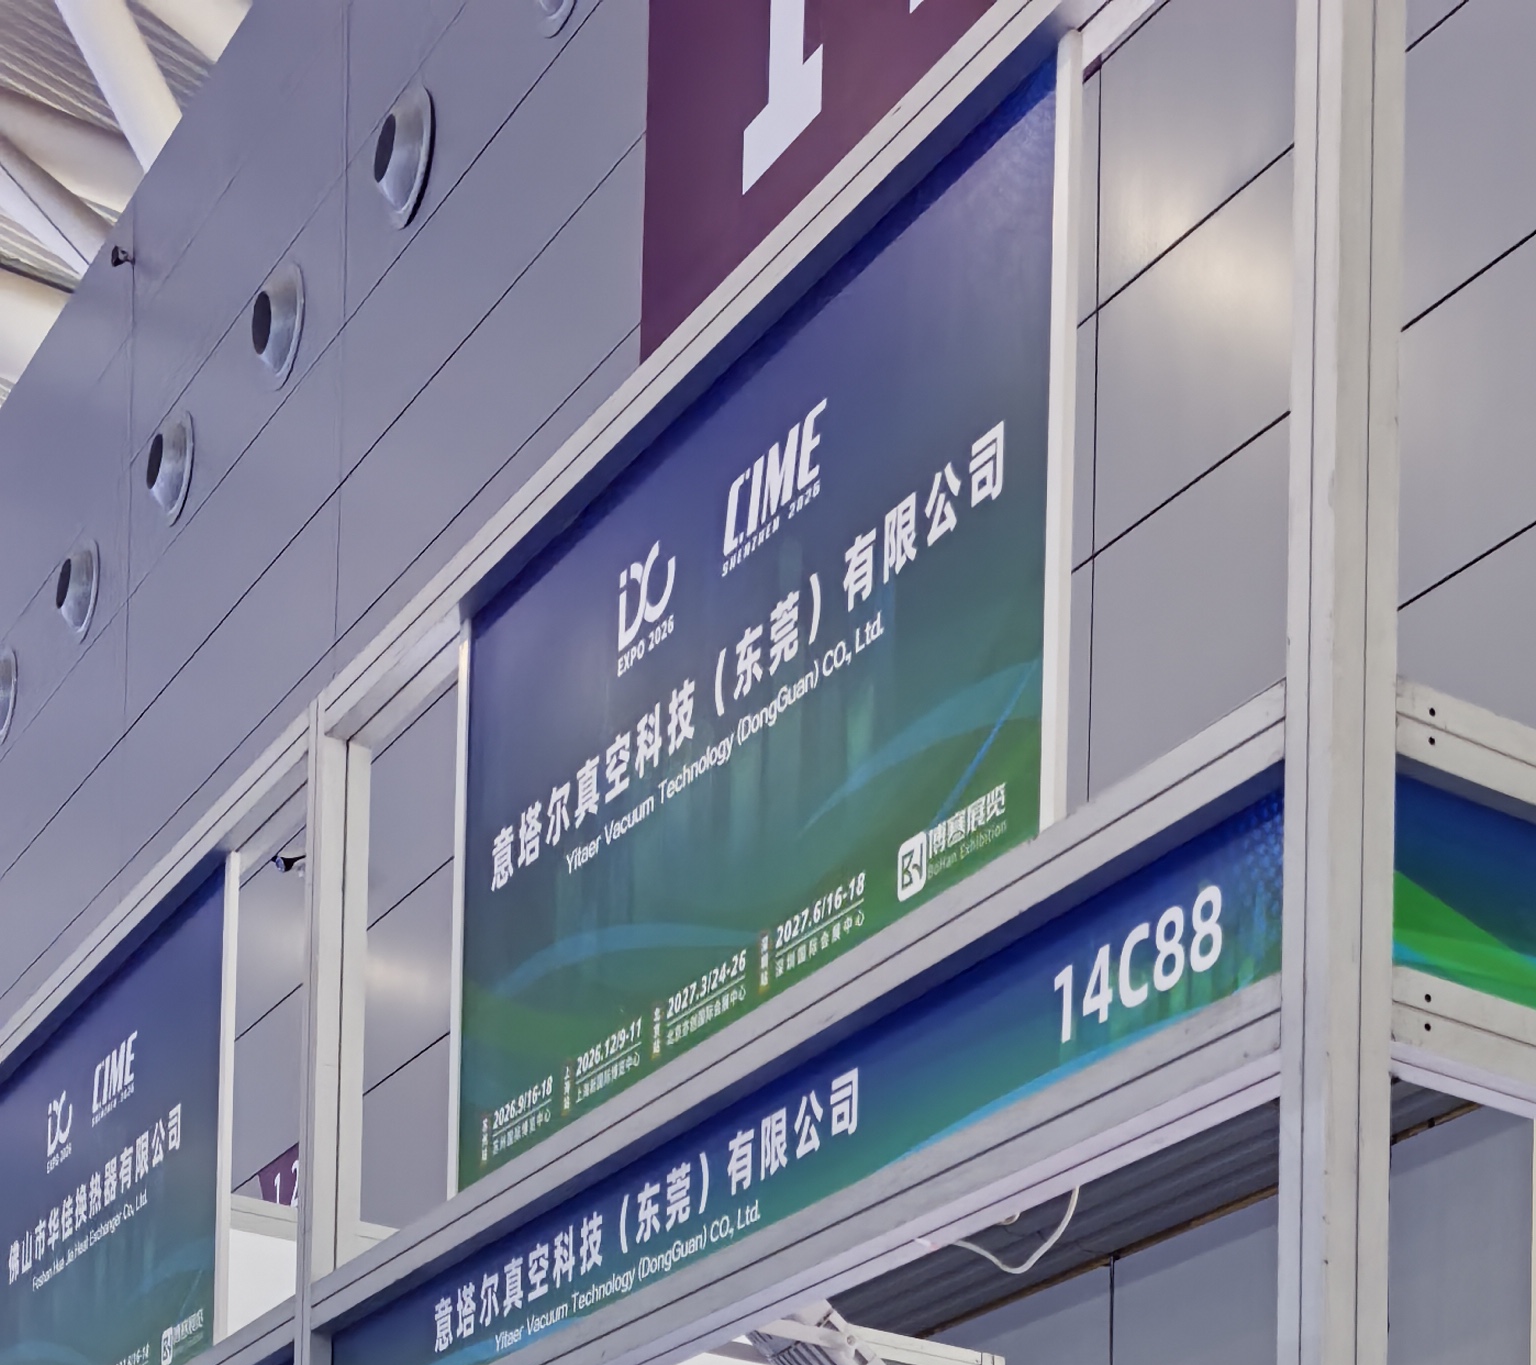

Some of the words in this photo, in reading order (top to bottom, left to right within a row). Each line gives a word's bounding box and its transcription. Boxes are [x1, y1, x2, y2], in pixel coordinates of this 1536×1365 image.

[722, 516, 780, 577] SHENZHEN
[788, 480, 820, 519] 2026
[490, 420, 1006, 893] 意塔尔真空科技（东莞）有限公司
[617, 639, 646, 678] EXPO
[647, 614, 674, 659] 2026
[566, 835, 603, 875] Yitaer
[604, 798, 655, 848] Vacuum
[658, 732, 735, 804] Technology
[737, 662, 820, 745] (DongGuan)
[854, 612, 885, 654] Ltd.
[775, 872, 865, 949] 2027.6/16-18
[666, 950, 747, 1019] 2027.3/24-26
[1053, 884, 1223, 1044] 14C88
[576, 1016, 642, 1077] 2026.12/9-11
[493, 1075, 553, 1129] 2026.9/16-18
[434, 1066, 860, 1354] 意塔尔真空科技（东莞）有限公司
[32, 1268, 52, 1292] Foshan
[494, 1321, 524, 1352] Yitaer
[527, 1299, 569, 1340] Vacuum
[571, 1268, 636, 1314] Technology
[638, 1233, 708, 1286] (DongGuan)
[736, 1199, 761, 1231] Ltd.
